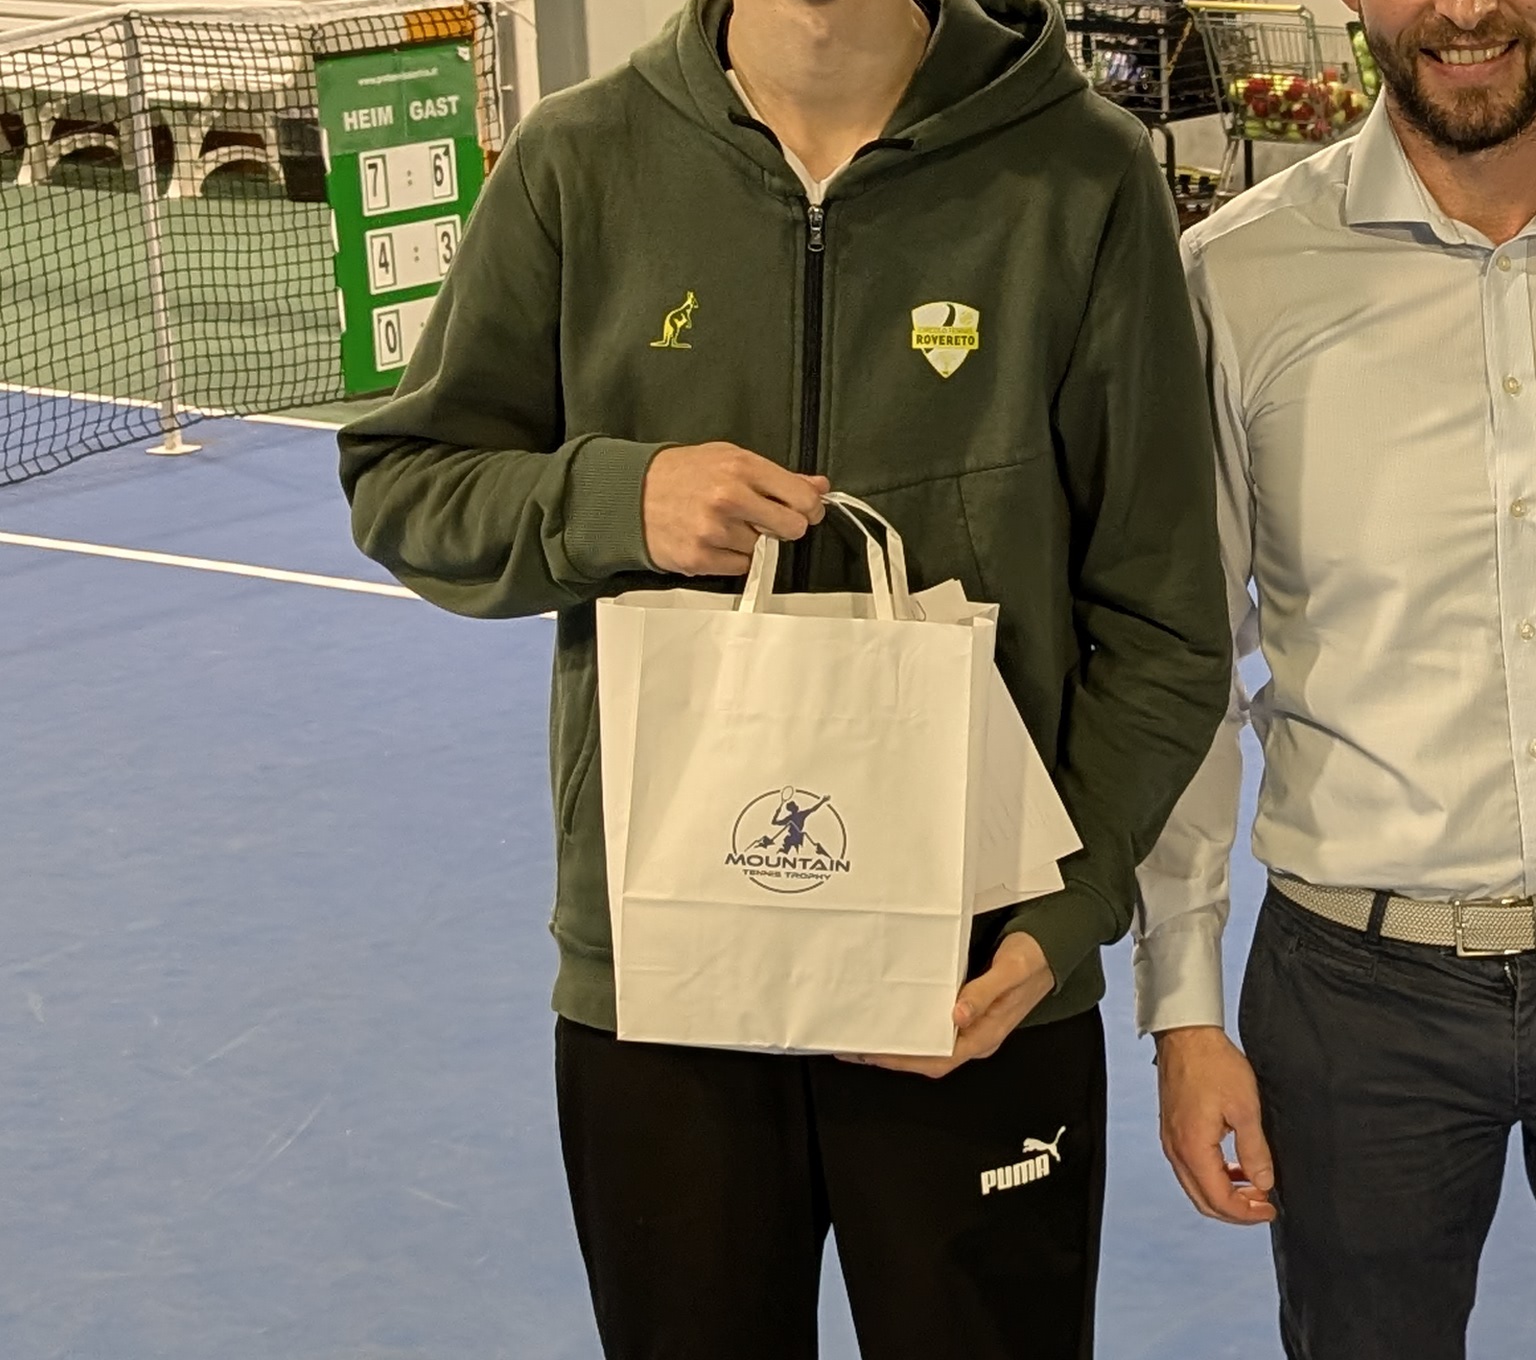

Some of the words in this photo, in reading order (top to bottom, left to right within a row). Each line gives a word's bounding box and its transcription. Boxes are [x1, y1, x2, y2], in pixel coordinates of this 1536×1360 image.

[343, 105, 394, 132] HEIM
[409, 95, 459, 121] GAST
[367, 162, 378, 197] 7
[432, 153, 444, 187] 6
[378, 241, 390, 274] 4
[440, 230, 454, 264] 3
[384, 319, 398, 354] 0
[915, 334, 976, 346] ROVERETO
[724, 852, 850, 873] MOUNTAIN
[742, 869, 782, 878] TENNIS
[784, 871, 831, 880] TROPHY
[980, 1153, 1051, 1195] PUMA
